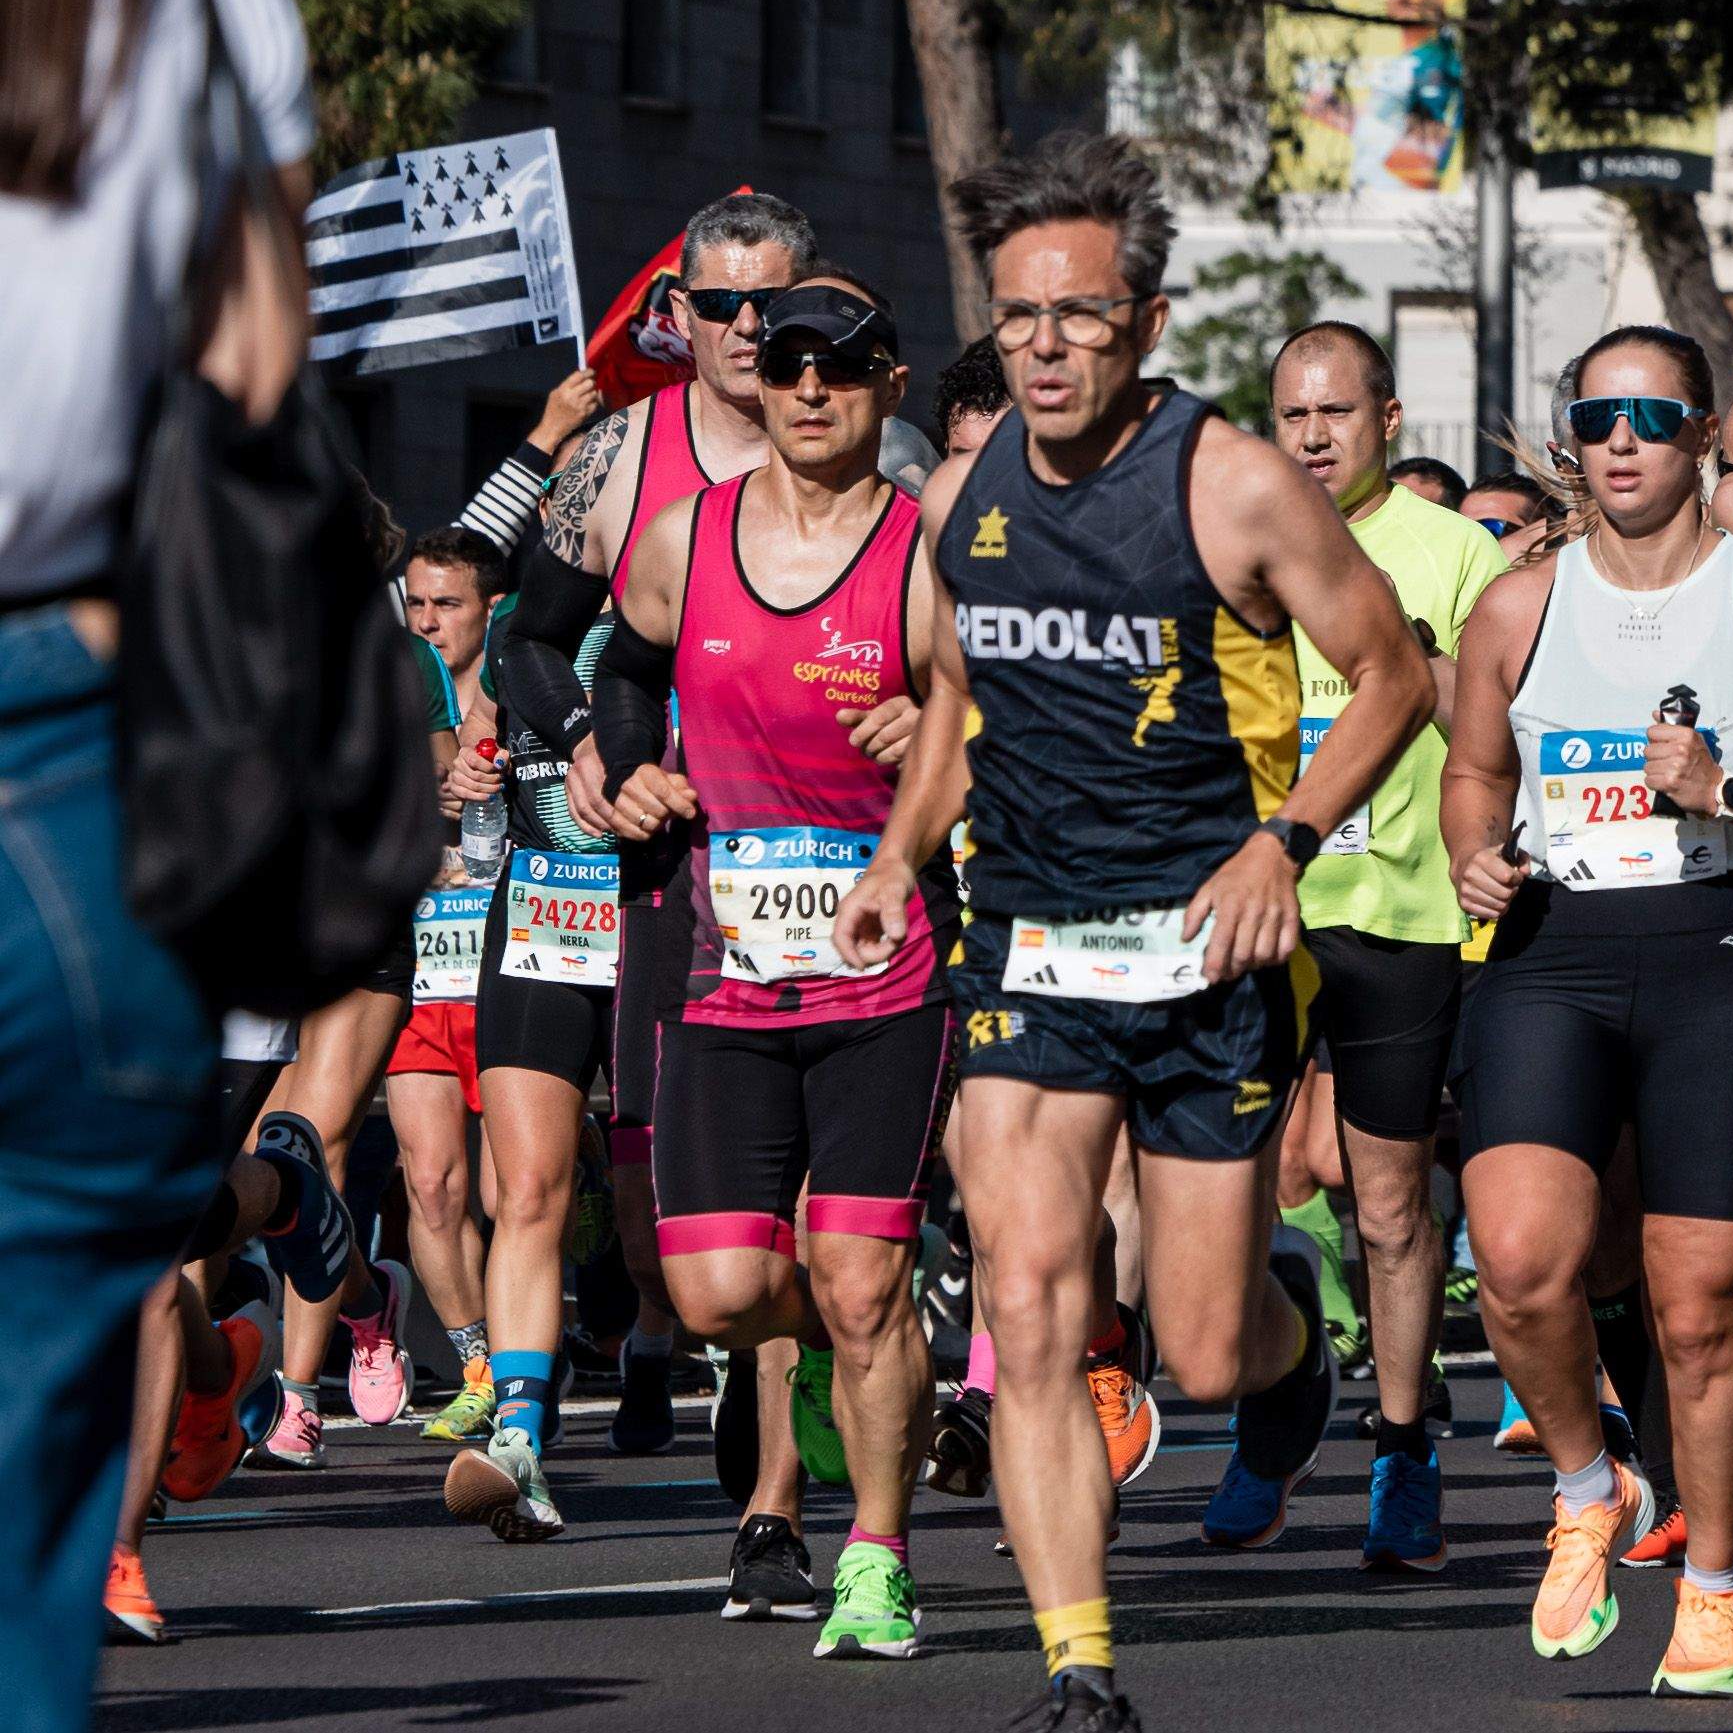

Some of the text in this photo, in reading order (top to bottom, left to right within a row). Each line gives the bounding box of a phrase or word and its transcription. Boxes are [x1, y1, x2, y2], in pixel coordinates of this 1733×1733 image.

[1601, 741, 1645, 761] ZUR
[1582, 785, 1652, 824] 223
[773, 839, 853, 861] ZURICH
[553, 863, 620, 880] ZURICH
[442, 897, 490, 913] ZURIC
[750, 882, 839, 920] 2900
[528, 896, 618, 933] 24228
[419, 930, 478, 957] 2611
[560, 934, 589, 948] NEREA
[785, 927, 812, 940] PIPE
[1079, 935, 1144, 951] ANTONIO
